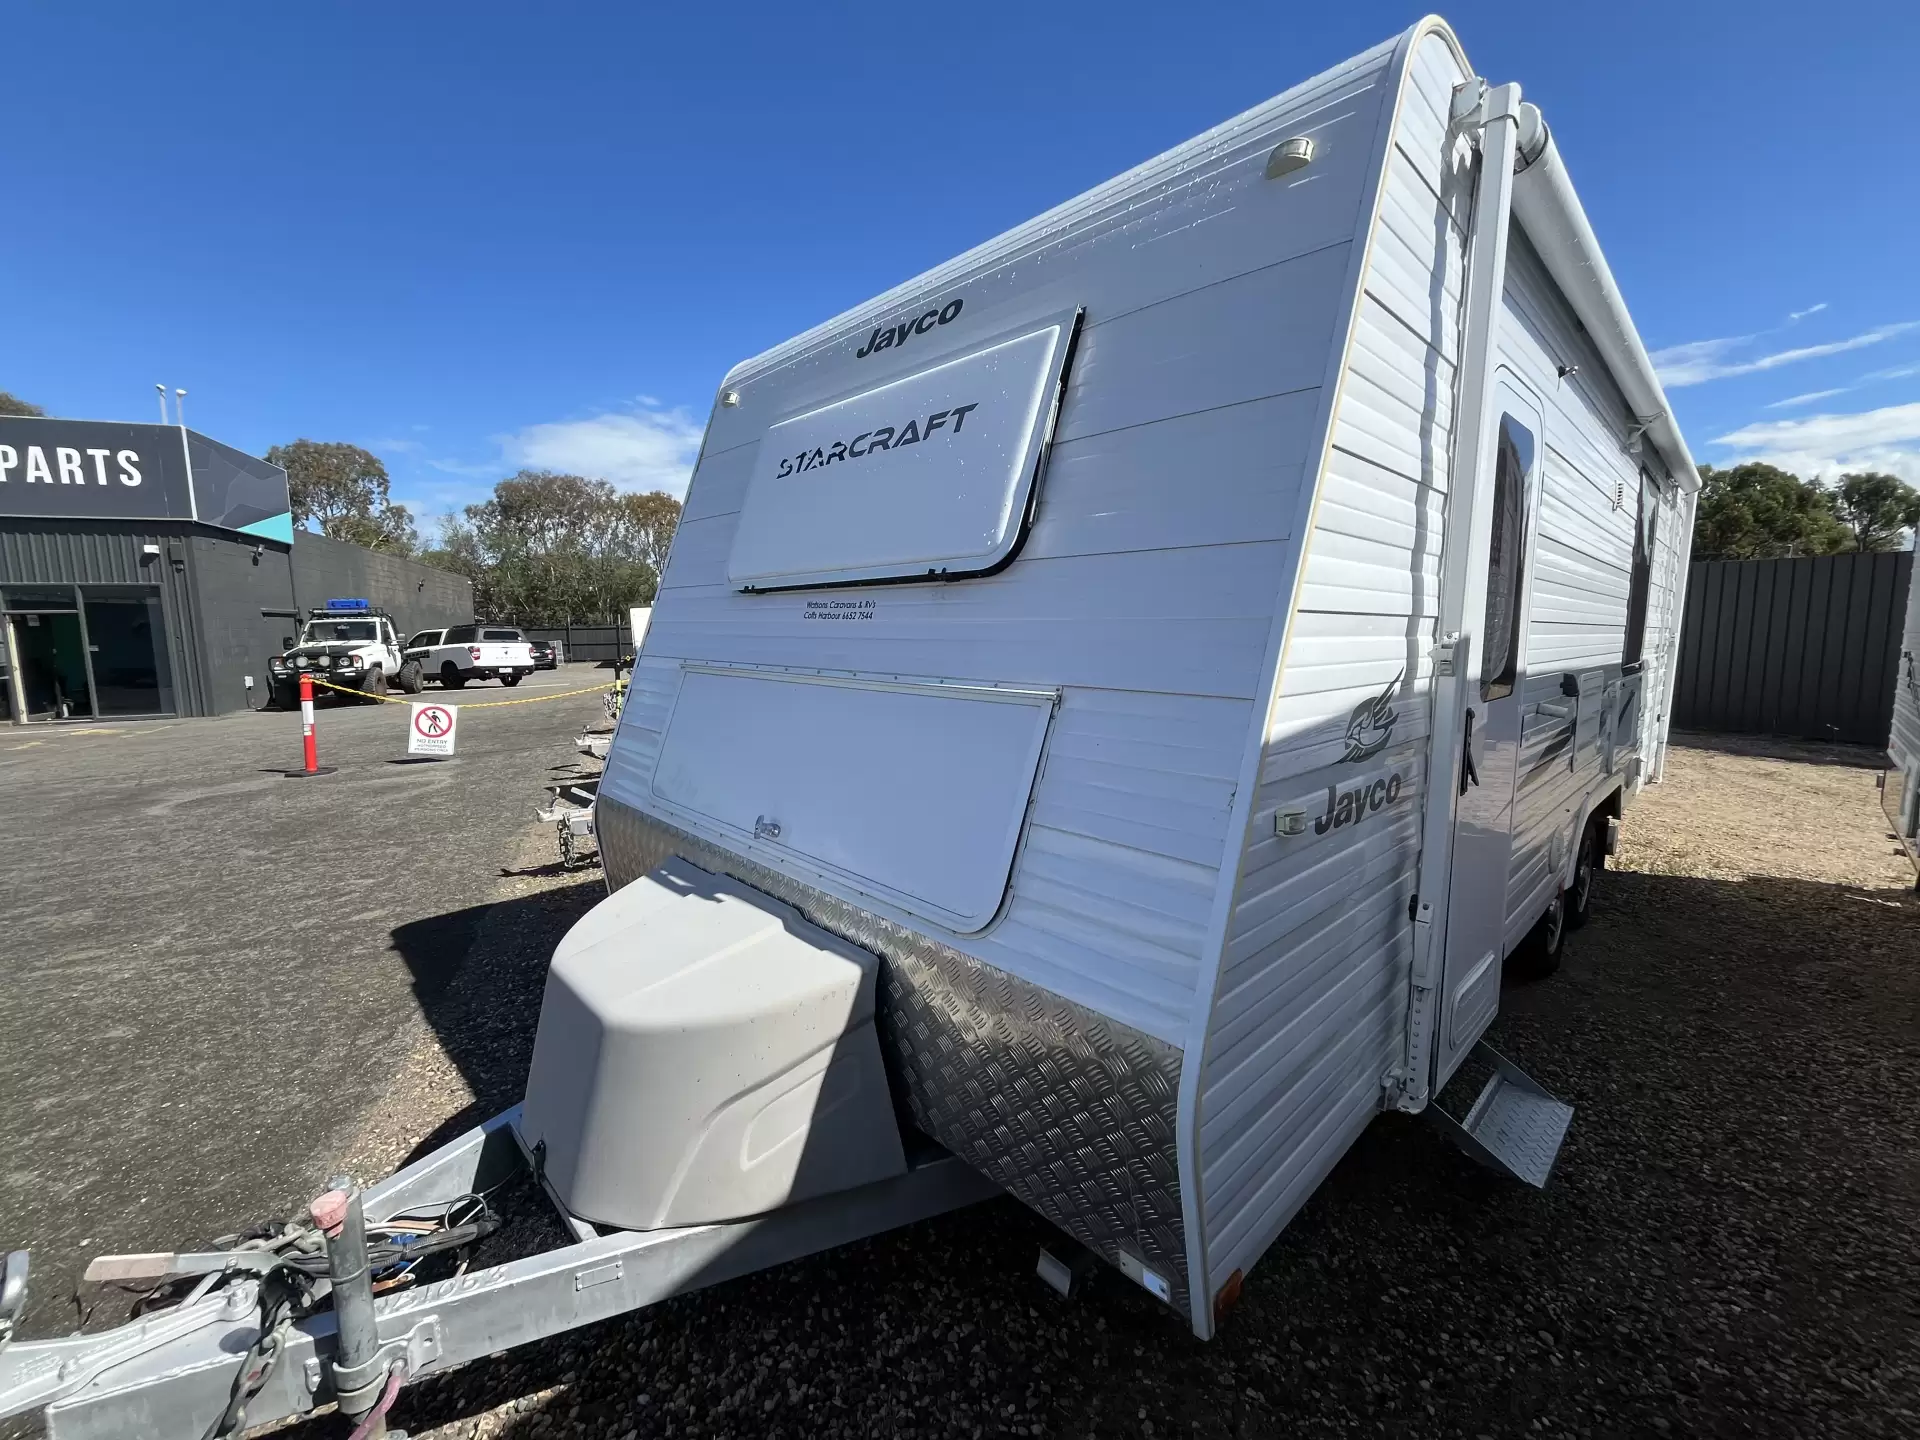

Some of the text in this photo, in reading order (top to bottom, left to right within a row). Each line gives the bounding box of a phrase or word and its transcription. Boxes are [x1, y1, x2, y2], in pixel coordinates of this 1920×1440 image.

[856, 298, 964, 359] Jayco
[0, 444, 142, 487] PARTS
[776, 402, 979, 479] STARCRAFT
[803, 611, 874, 620] Coffs Harbour 6652 7544
[829, 600, 857, 609] Caravans
[858, 601, 863, 609] &
[1314, 772, 1402, 836] Jayco
